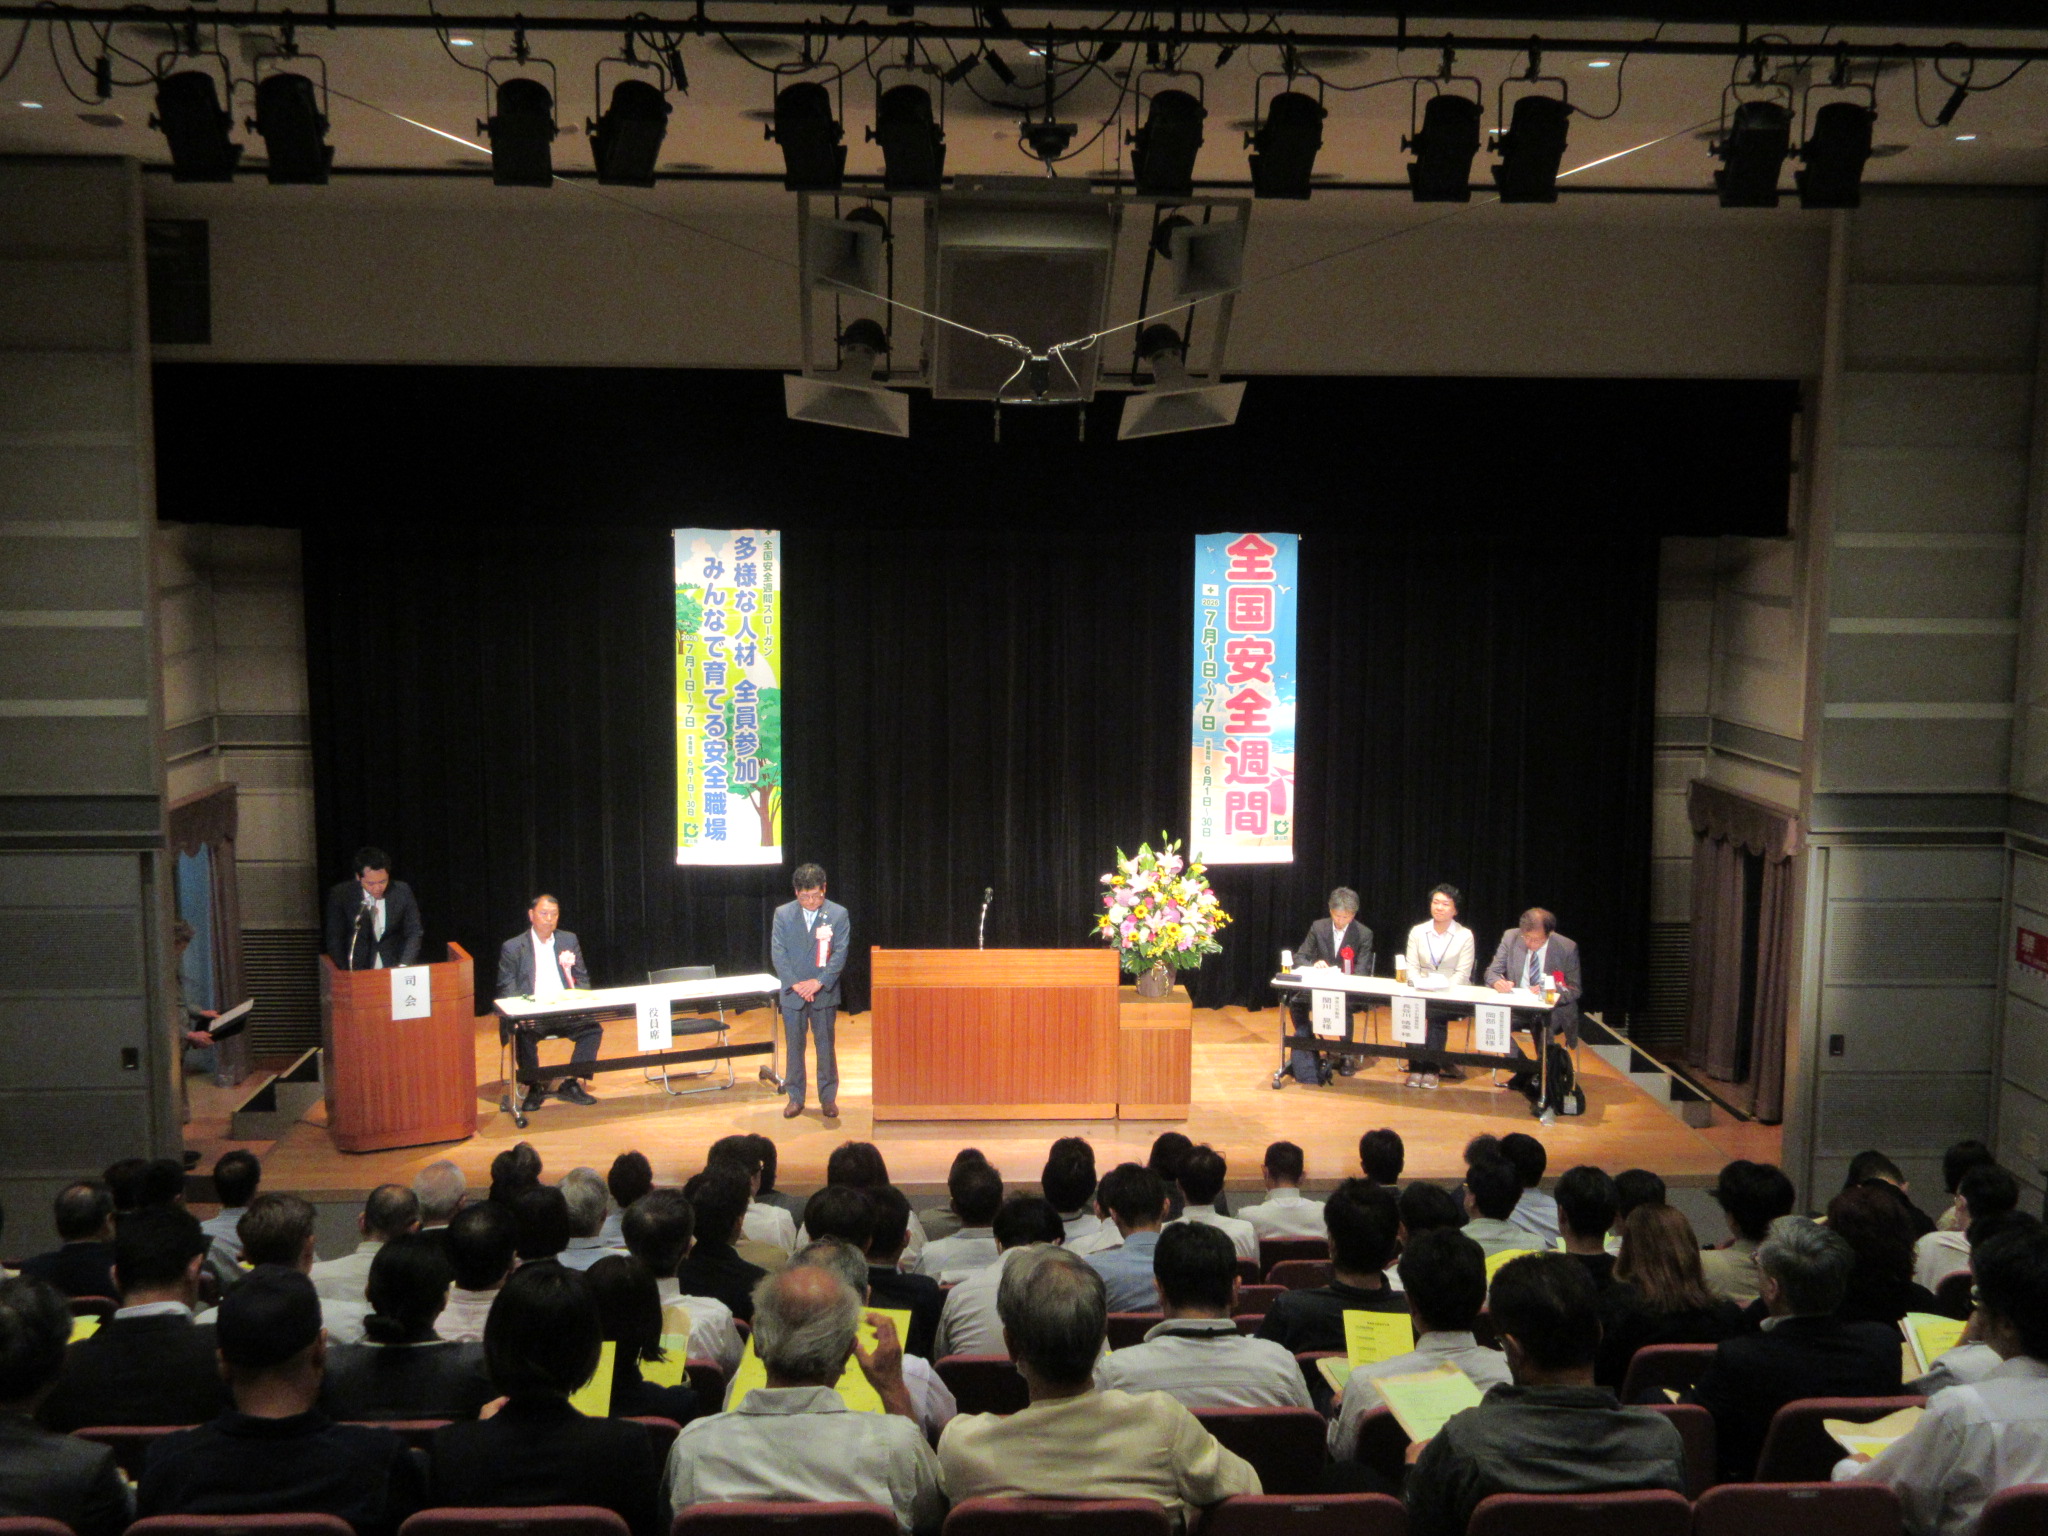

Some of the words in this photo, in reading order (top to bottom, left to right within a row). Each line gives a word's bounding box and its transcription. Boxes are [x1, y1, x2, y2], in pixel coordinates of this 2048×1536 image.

[734, 536, 757, 667] 多様な人材
[763, 540, 773, 656] 全国安全週間スローガン
[703, 557, 727, 841] みんなで育てる安全職場
[734, 679, 758, 782] 全員参加
[1225, 534, 1275, 835] 全国安全週間
[404, 975, 416, 1006] 司会
